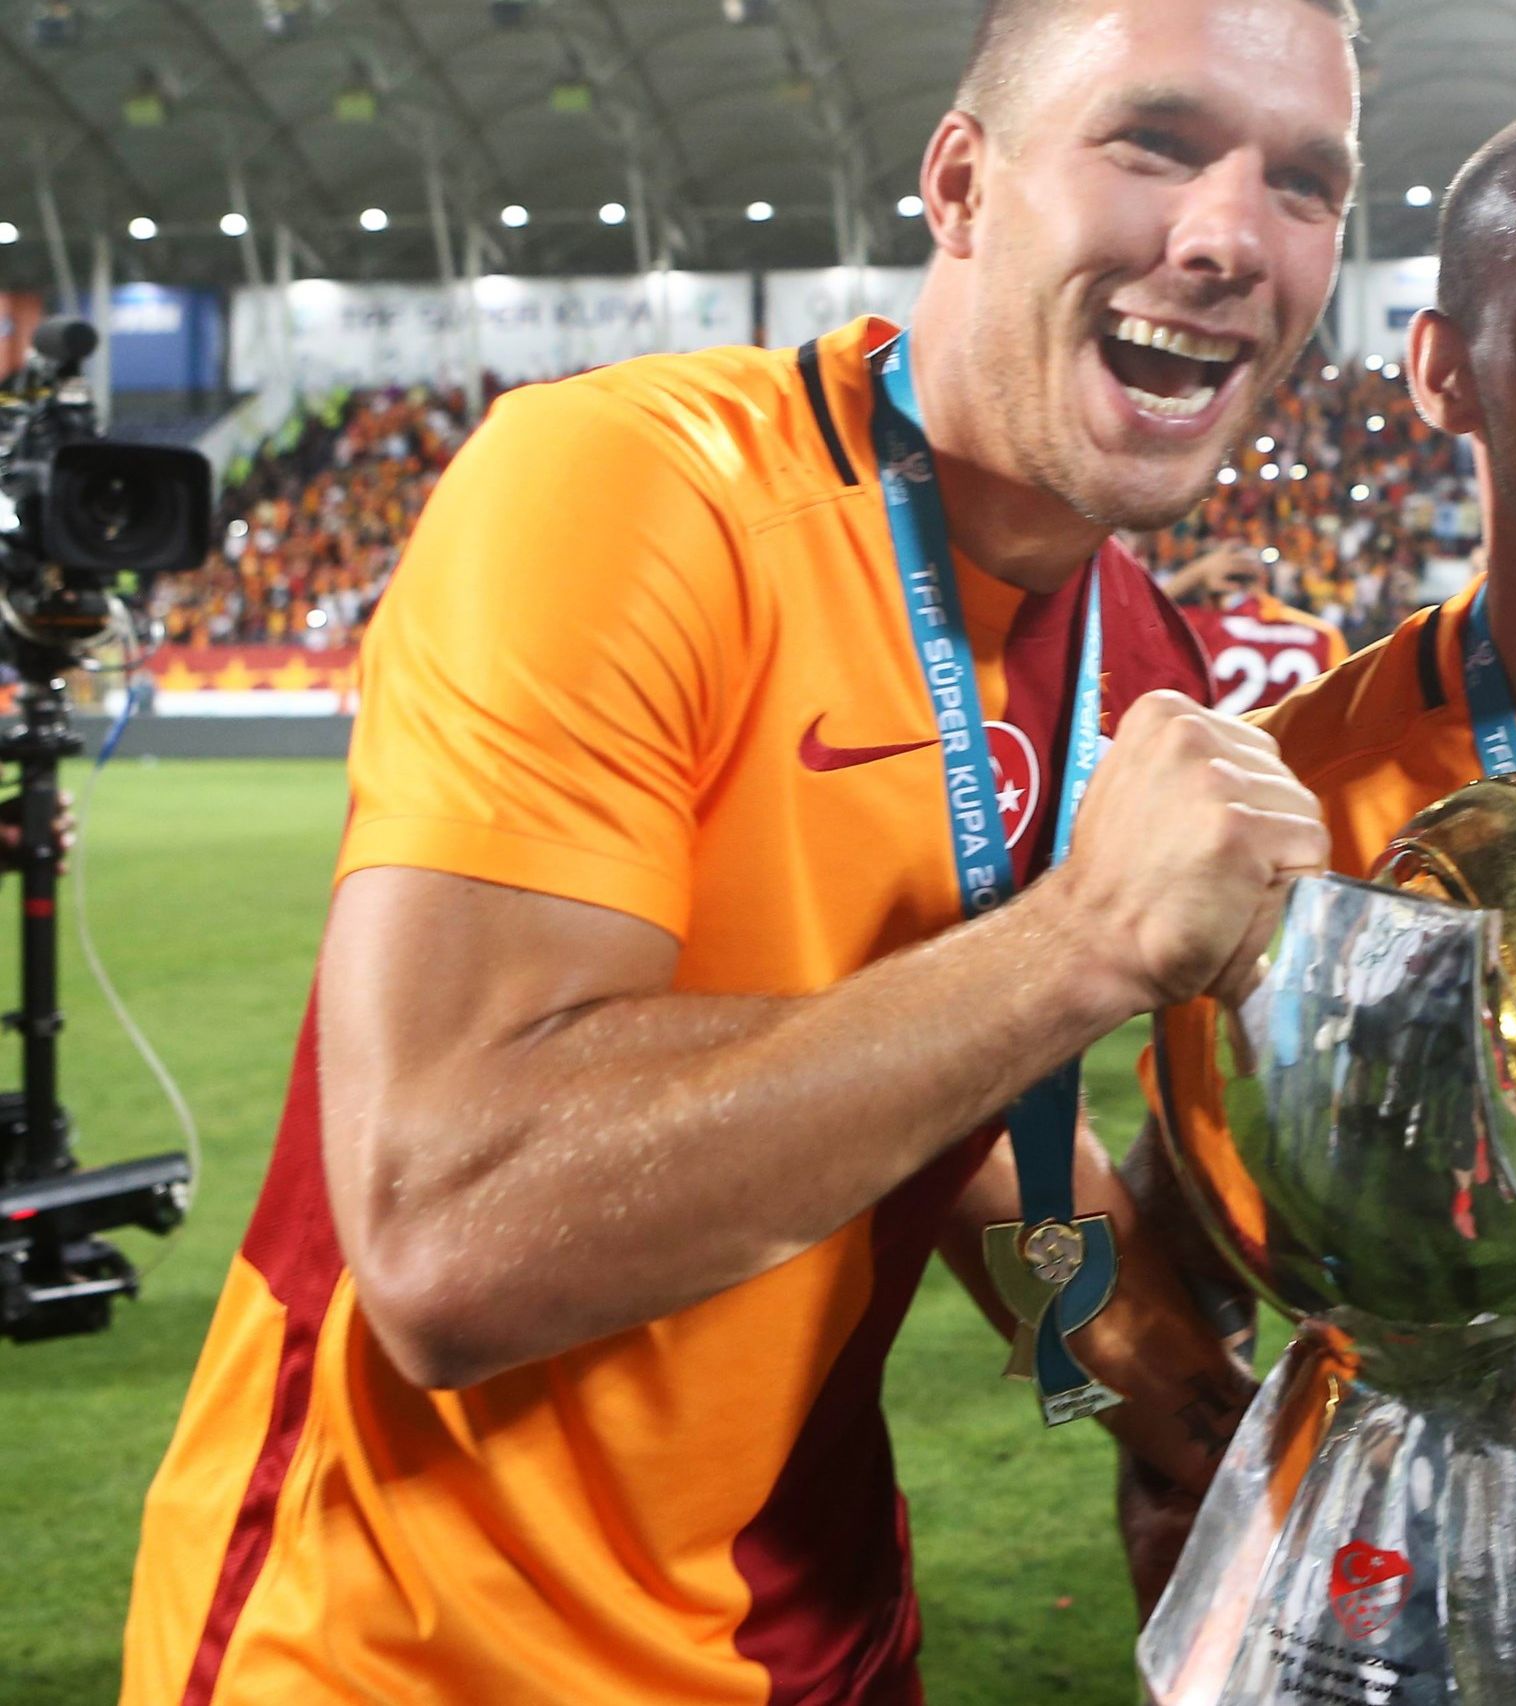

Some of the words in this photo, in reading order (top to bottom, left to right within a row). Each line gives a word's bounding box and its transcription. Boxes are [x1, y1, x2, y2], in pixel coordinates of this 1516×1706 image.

[909, 563, 947, 627] TFF
[923, 637, 971, 756] SÜPER
[947, 765, 989, 858] KUPA
